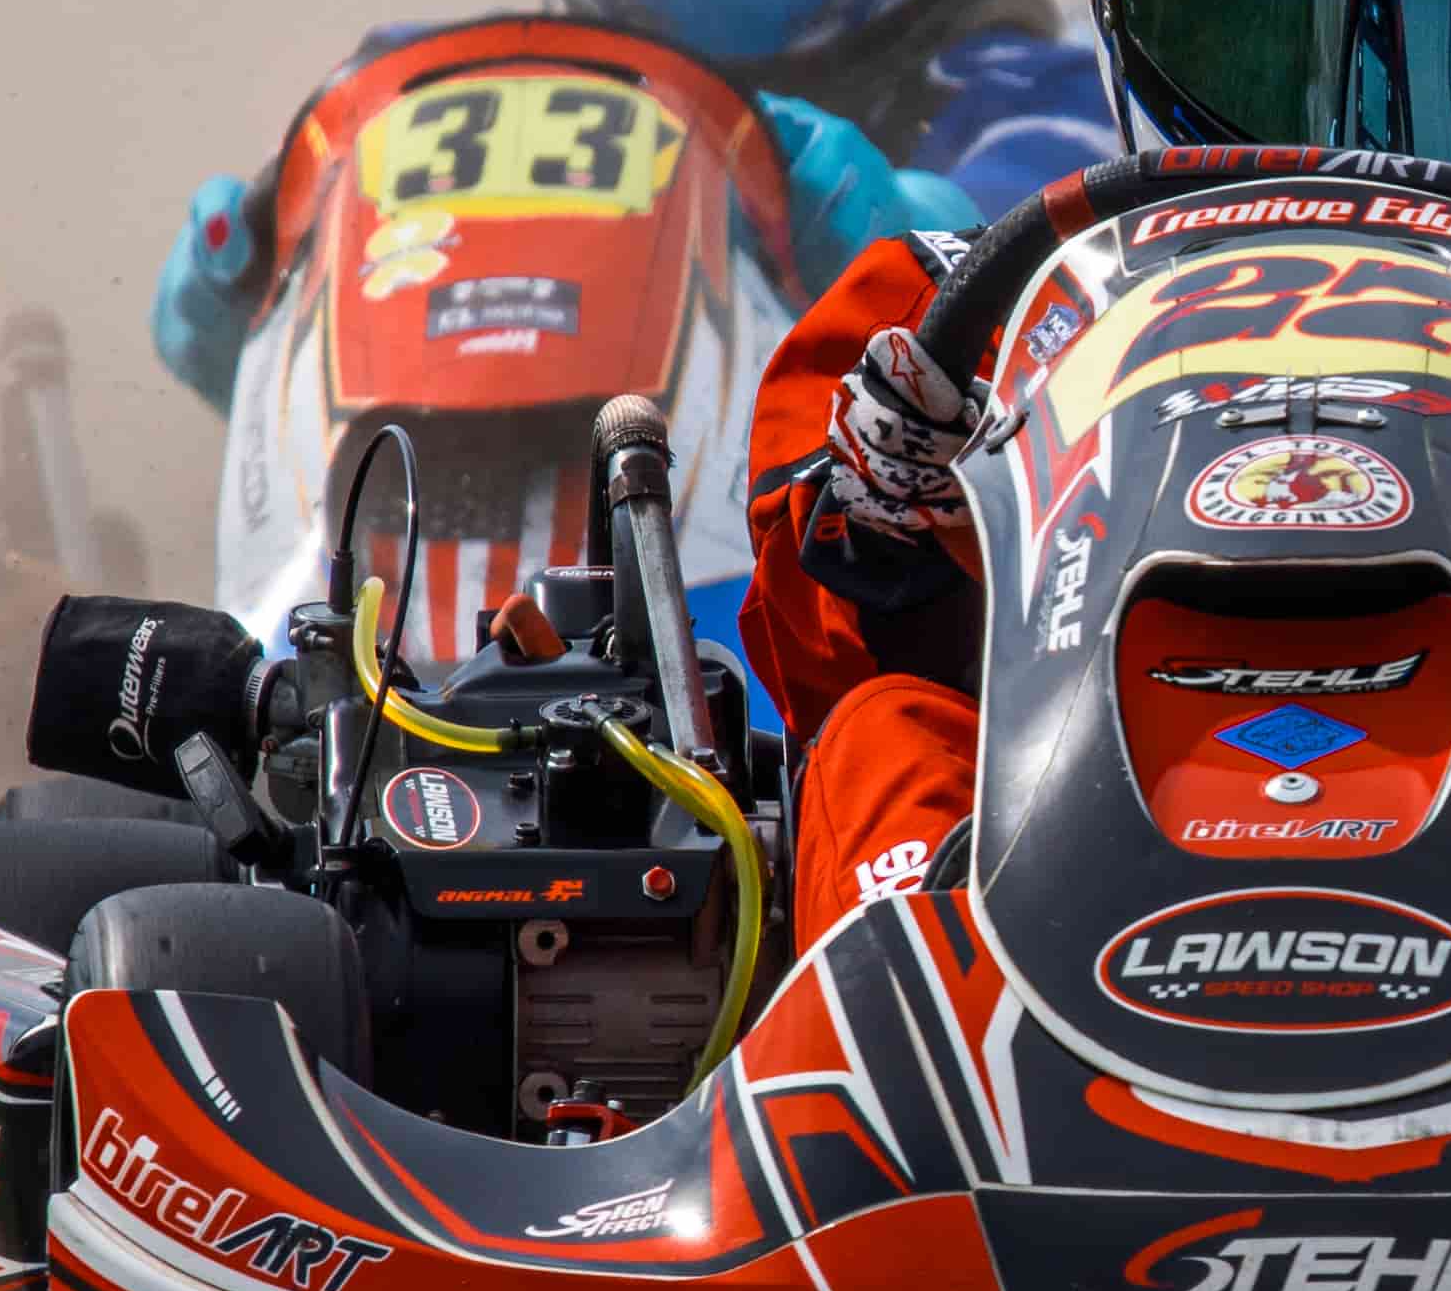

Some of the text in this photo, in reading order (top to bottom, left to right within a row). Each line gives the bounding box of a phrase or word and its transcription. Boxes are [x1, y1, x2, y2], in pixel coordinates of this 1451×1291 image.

[395, 88, 638, 200] 33
[1132, 196, 1355, 247] Creative
[109, 616, 158, 759] Outerwears
[419, 772, 458, 841] LAWSON
[1205, 979, 1373, 998] SPEED SHOP
